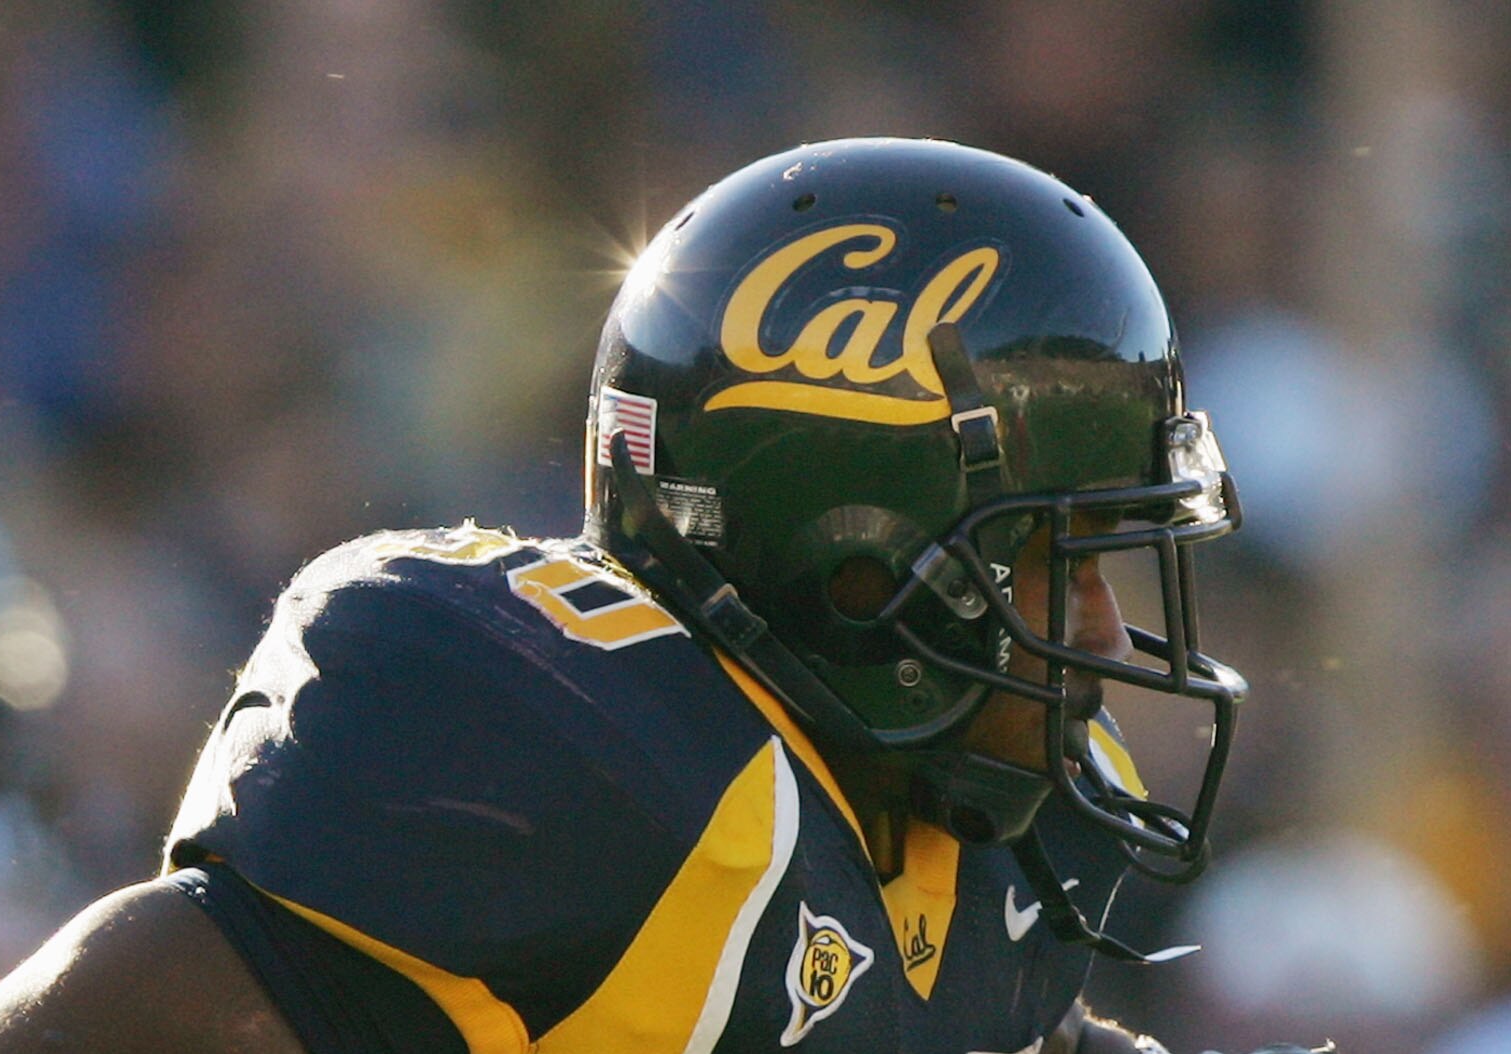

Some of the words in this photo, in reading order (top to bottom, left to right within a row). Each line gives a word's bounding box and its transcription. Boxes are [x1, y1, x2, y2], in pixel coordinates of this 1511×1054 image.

[703, 223, 1000, 426] Cal
[904, 913, 936, 972] Cal
[808, 970, 834, 1001] 10
